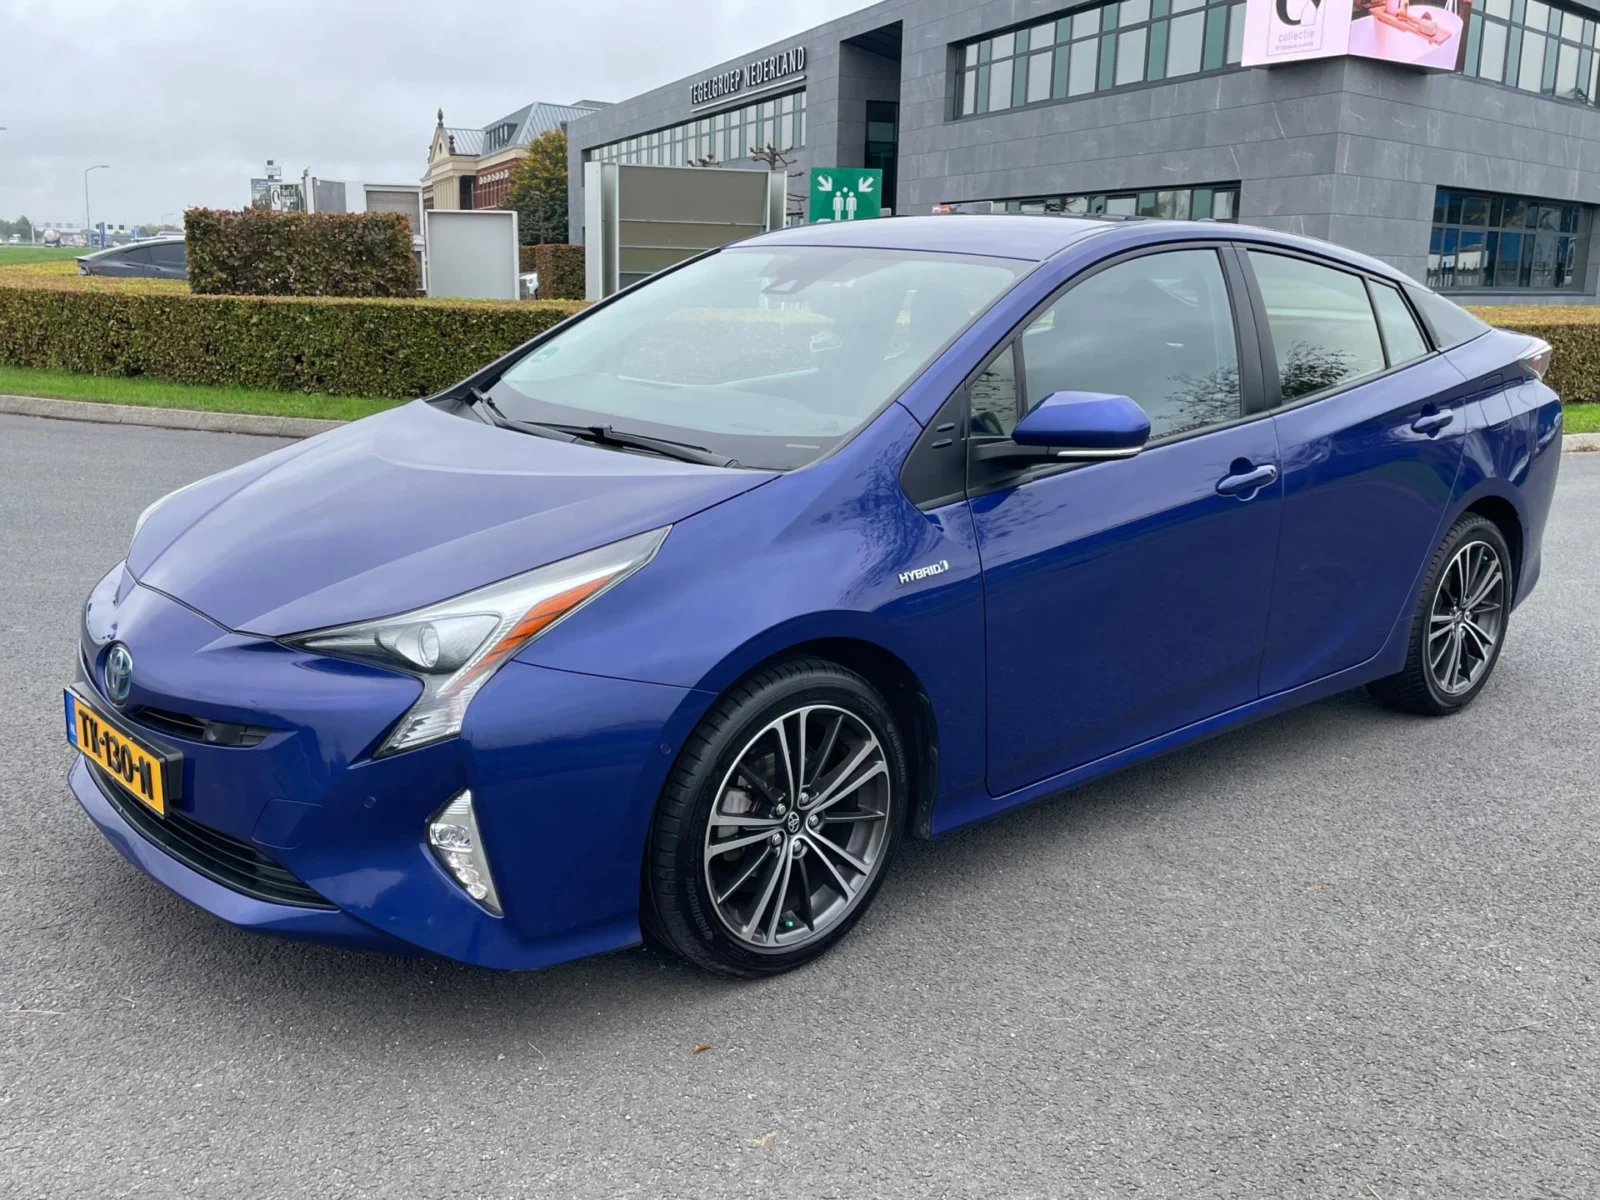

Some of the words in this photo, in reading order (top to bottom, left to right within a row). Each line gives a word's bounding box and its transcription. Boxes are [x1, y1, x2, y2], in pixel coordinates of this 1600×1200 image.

[1278, 29, 1315, 42] collectie
[690, 69, 741, 104] TEGELGROEP
[744, 46, 805, 87] NEDERLAND
[899, 562, 943, 584] HYBRID
[78, 709, 154, 800] TK-130-N
